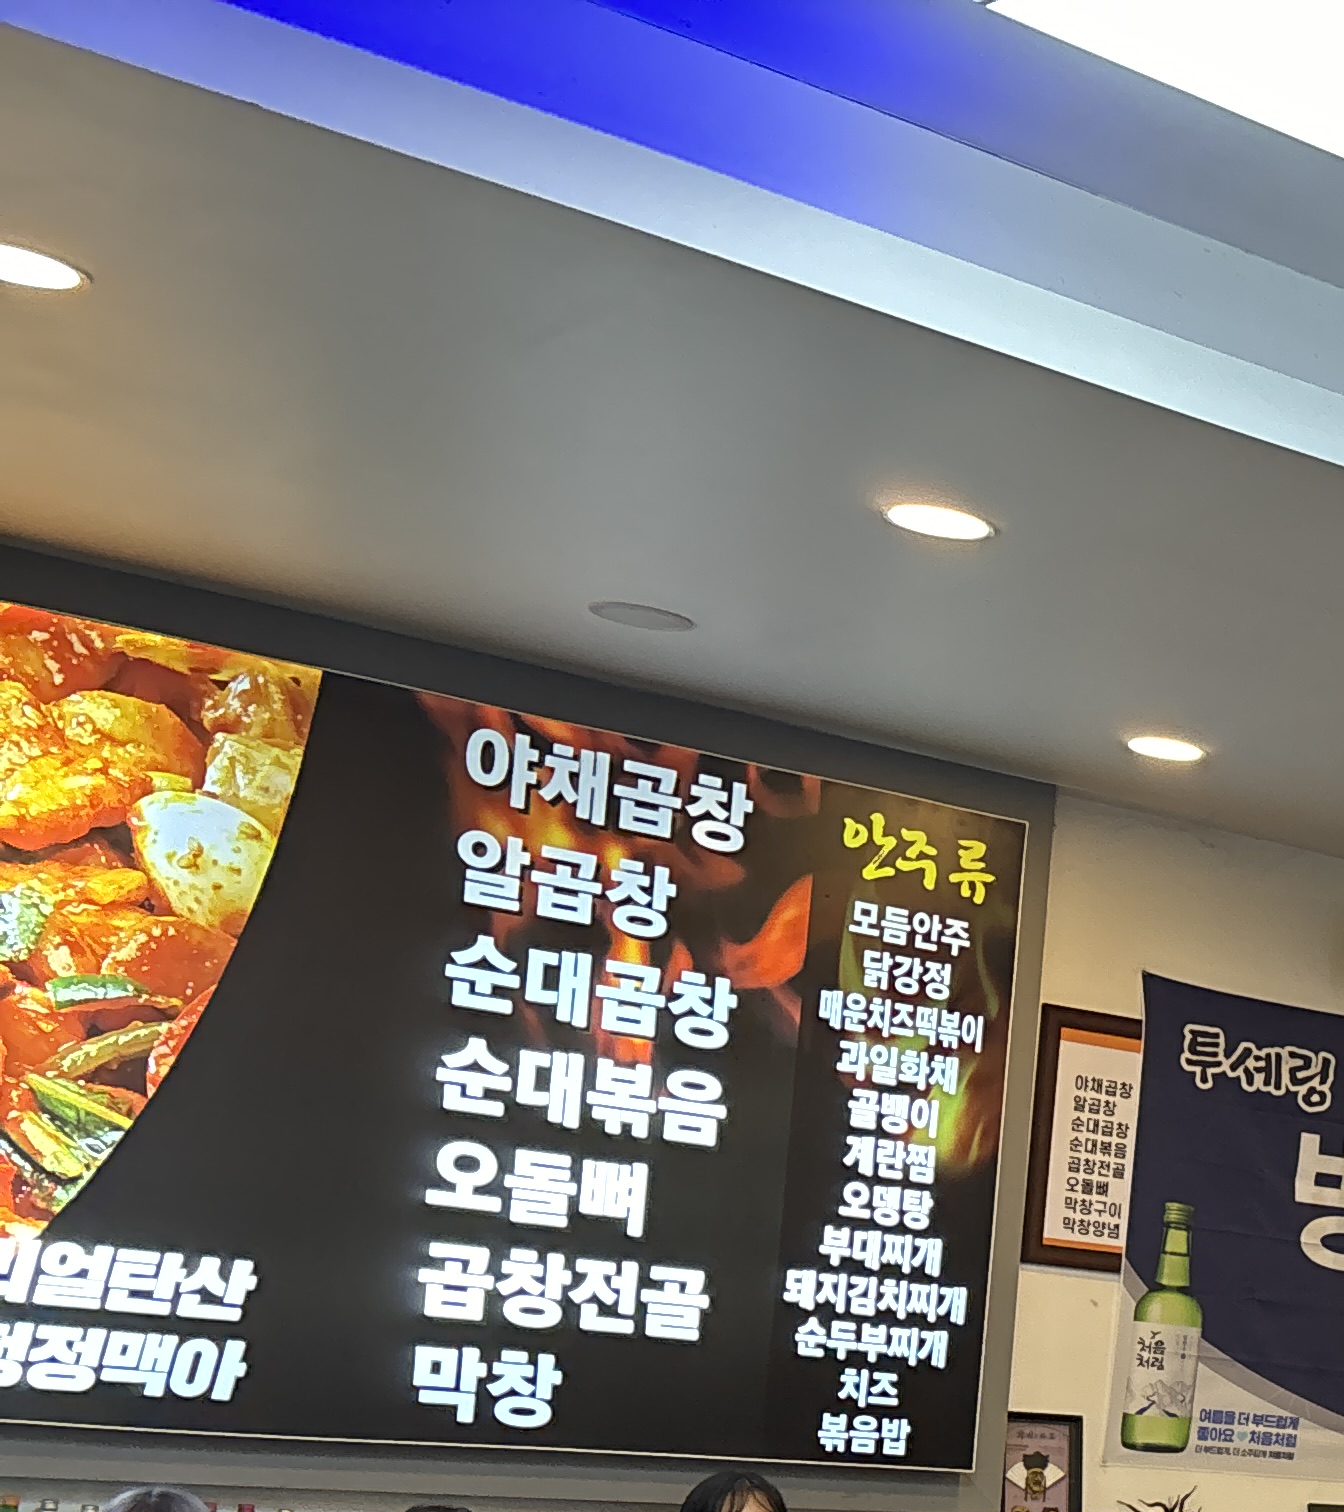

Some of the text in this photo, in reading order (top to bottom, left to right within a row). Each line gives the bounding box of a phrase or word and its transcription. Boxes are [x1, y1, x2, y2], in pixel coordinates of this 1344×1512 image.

[465, 728, 754, 854] 야채곱창
[843, 812, 996, 905] 안주 류
[456, 830, 677, 939] 알곱창
[849, 900, 970, 956] 모듬안주
[444, 934, 738, 1050] 순대곱창
[863, 950, 952, 1001] 닭강정
[818, 989, 984, 1053] 매운치즈떡볶이
[435, 1035, 727, 1149] 순대볶음
[836, 1040, 959, 1095] 과일화채
[1075, 1074, 1133, 1099] 야채곱창
[848, 1088, 940, 1139] 골뱅이
[1071, 1116, 1130, 1140] 순대곱창
[1073, 1095, 1117, 1117] 알곱창
[842, 1136, 936, 1185] 계란찜
[1068, 1156, 1126, 1180] 곱창전골
[1069, 1136, 1128, 1160] 순대볶음
[425, 1141, 649, 1239] 오돌뼈
[838, 1181, 935, 1230] 오뎅탕
[1064, 1196, 1122, 1219] 막창구이
[819, 1225, 943, 1278] 부대찌개
[1063, 1217, 1120, 1239] 막창양념
[417, 1241, 709, 1341] 곱창전골
[783, 1269, 967, 1326] 돼지김치찌개
[795, 1316, 949, 1369] 순두부찌개
[1136, 1335, 1167, 1355] 처음
[1136, 1353, 1165, 1371] 처럼
[411, 1346, 563, 1428] 막창
[837, 1367, 899, 1408] 치즈
[818, 1412, 912, 1457] 볶음밥
[1237, 1412, 1250, 1426] 더
[1248, 1430, 1297, 1448] 처음처럼
